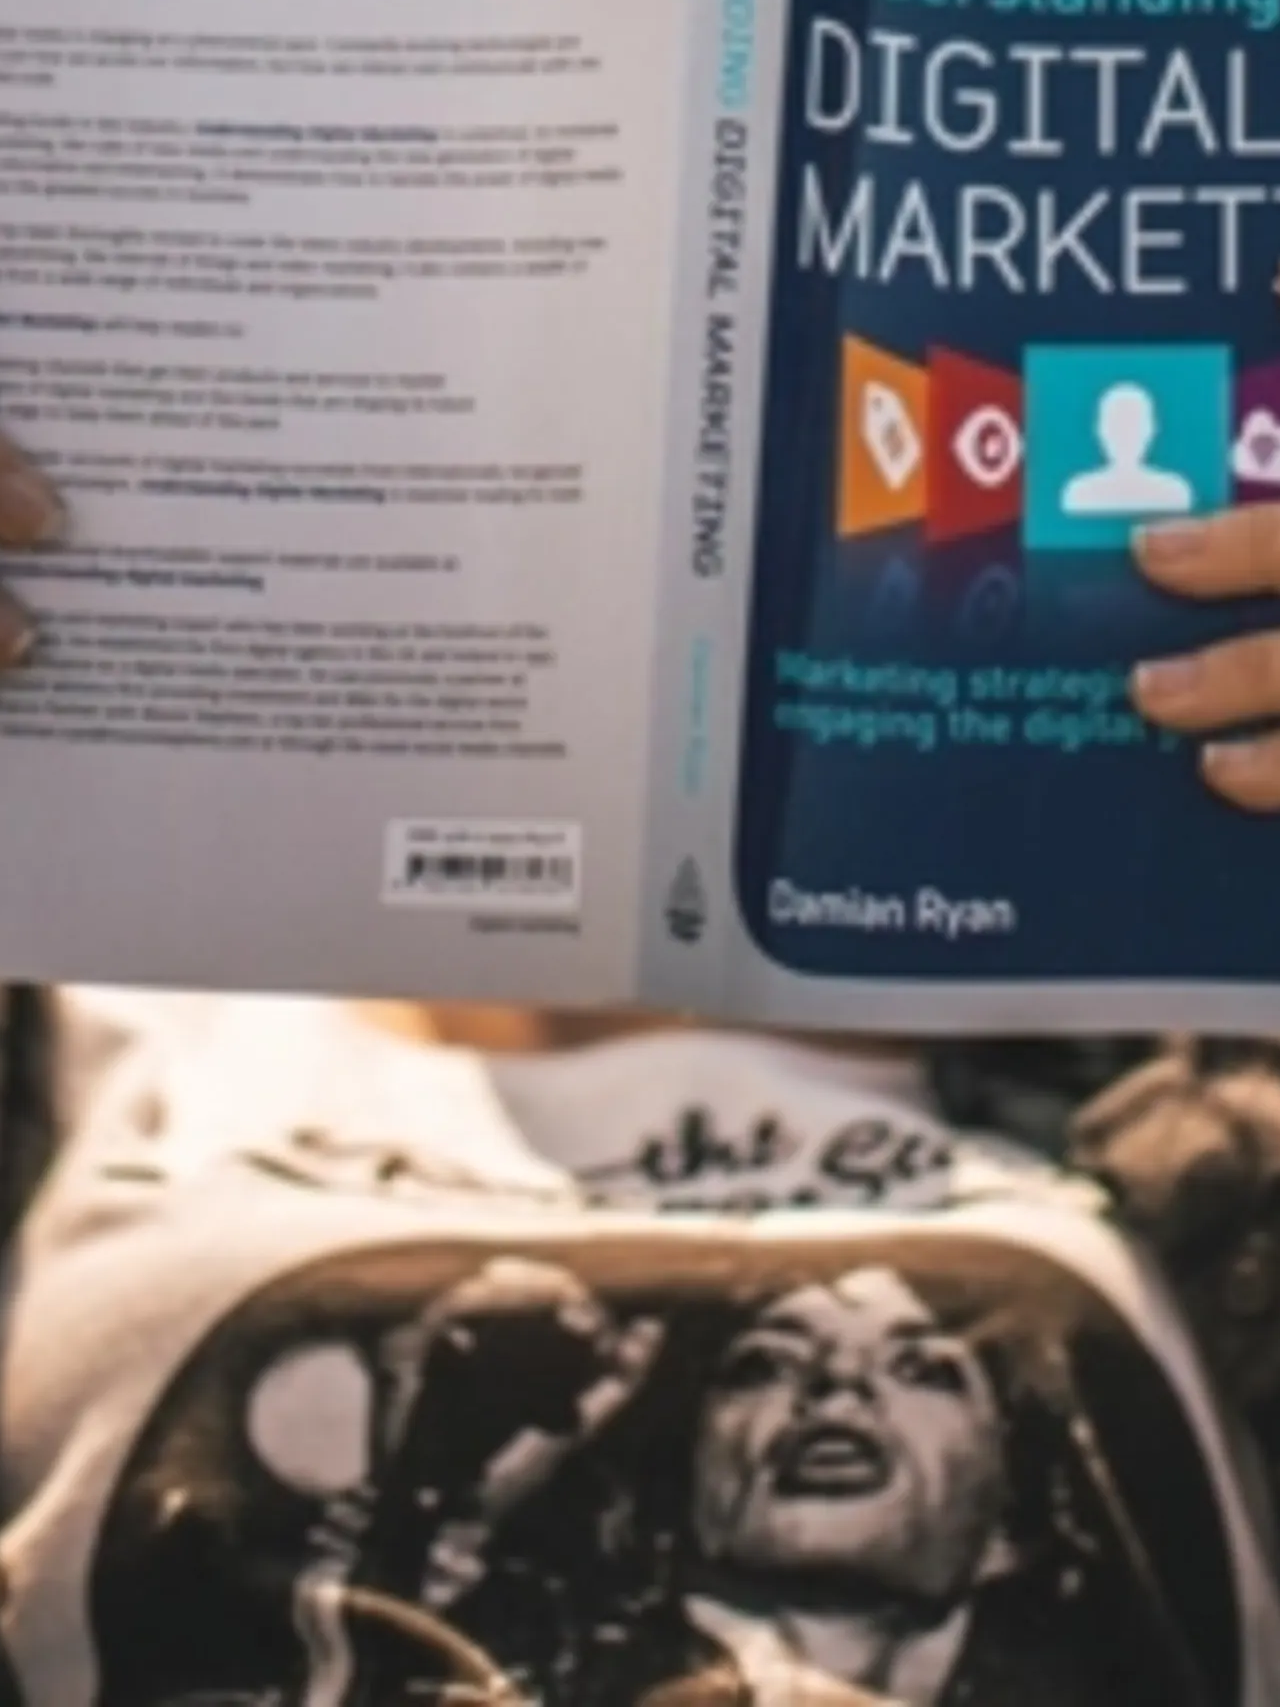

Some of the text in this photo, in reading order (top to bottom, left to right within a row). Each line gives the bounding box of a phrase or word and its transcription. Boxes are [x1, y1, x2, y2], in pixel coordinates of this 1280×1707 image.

[707, 117, 748, 300] DIGITAL
[691, 314, 736, 579] MARKETING
[775, 650, 1136, 706] Marketing strategi
[773, 702, 937, 752] engaging
[948, 703, 1011, 745] the
[768, 877, 906, 931] Damian
[914, 884, 1018, 941] Ryan
